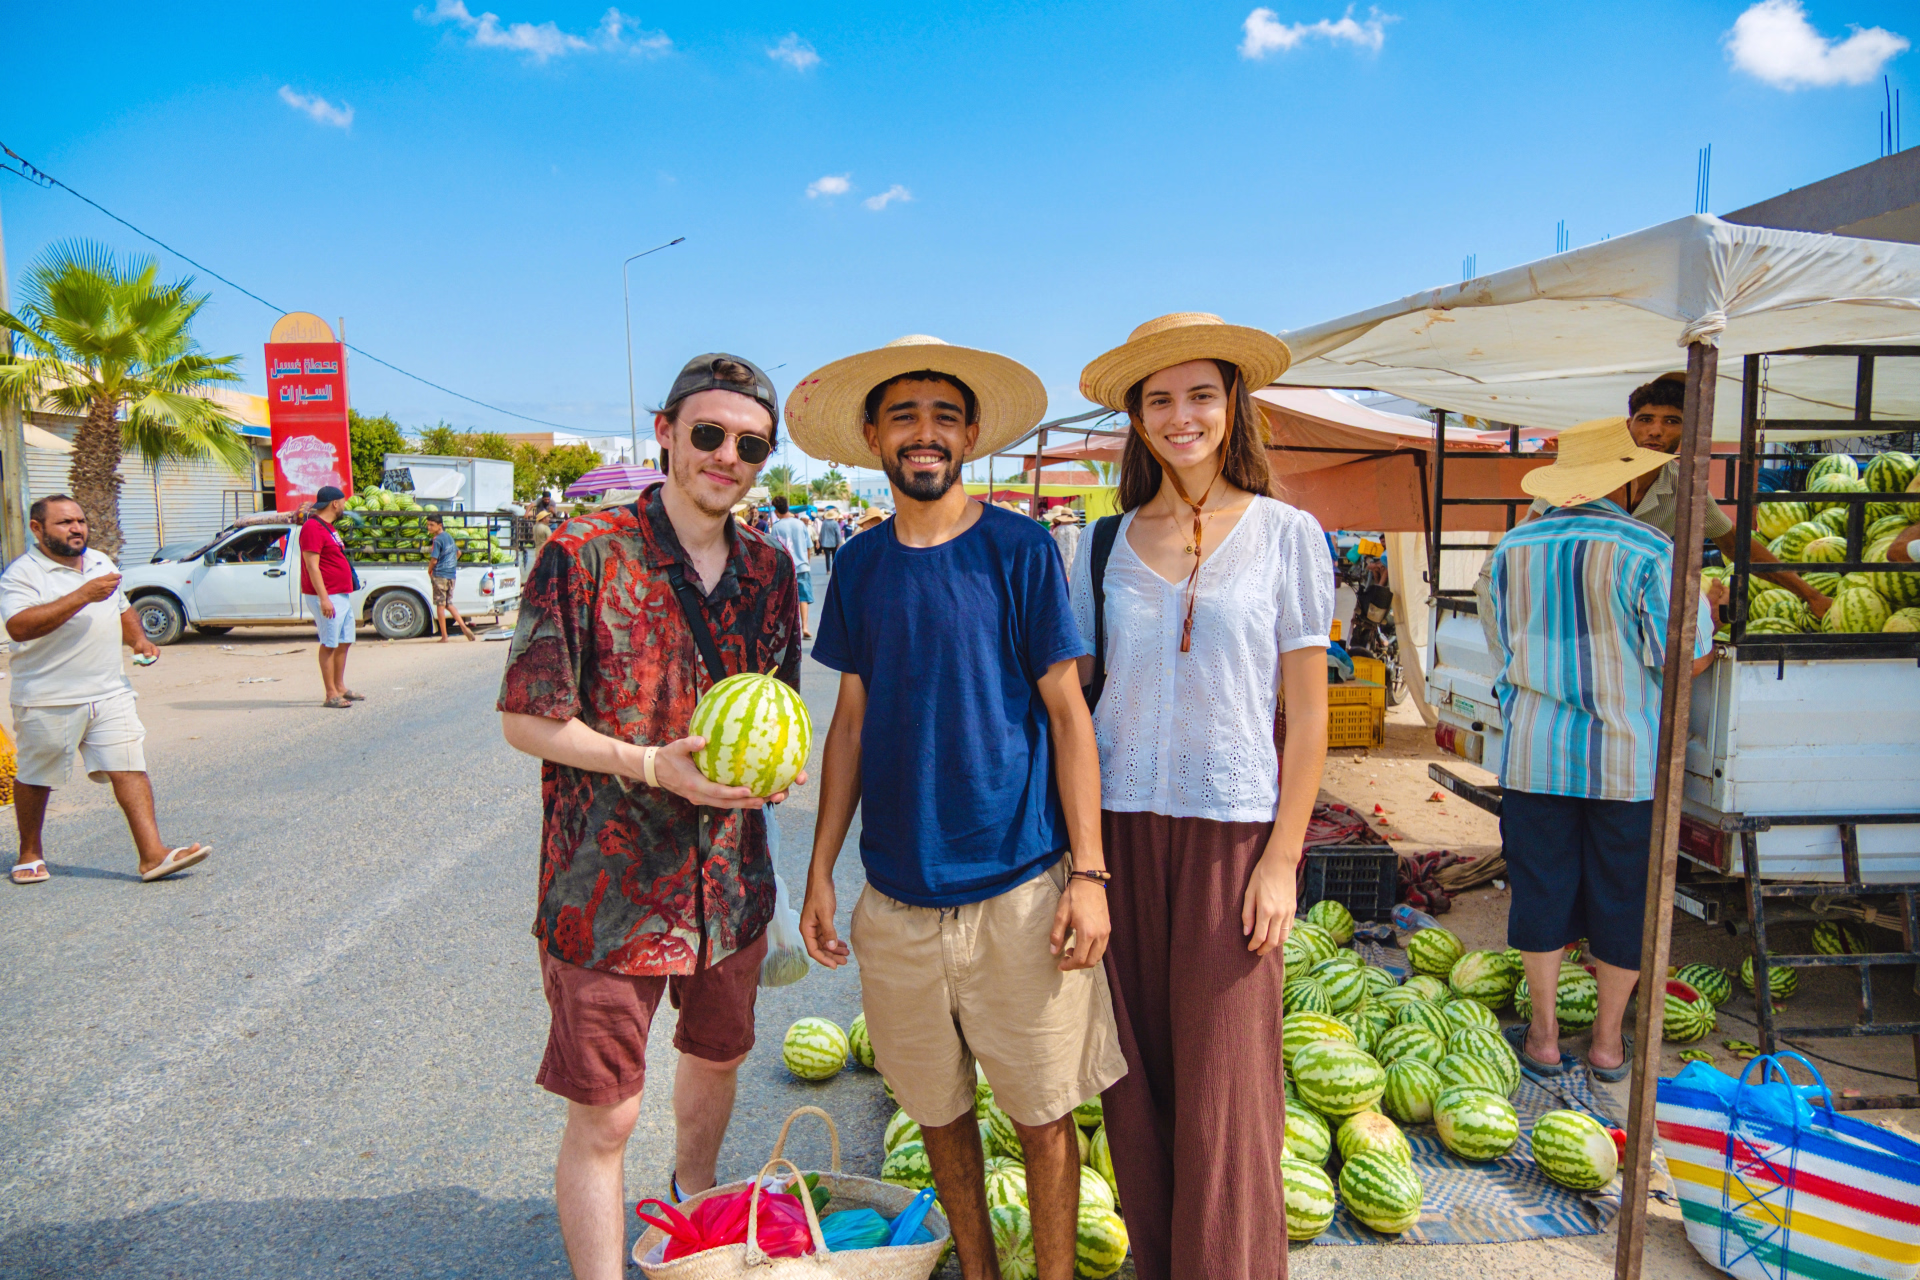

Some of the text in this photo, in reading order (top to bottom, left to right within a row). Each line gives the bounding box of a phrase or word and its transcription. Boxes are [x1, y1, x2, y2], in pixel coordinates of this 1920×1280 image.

[270, 358, 338, 379] محطة غسيل
[280, 384, 332, 405] السيارات
